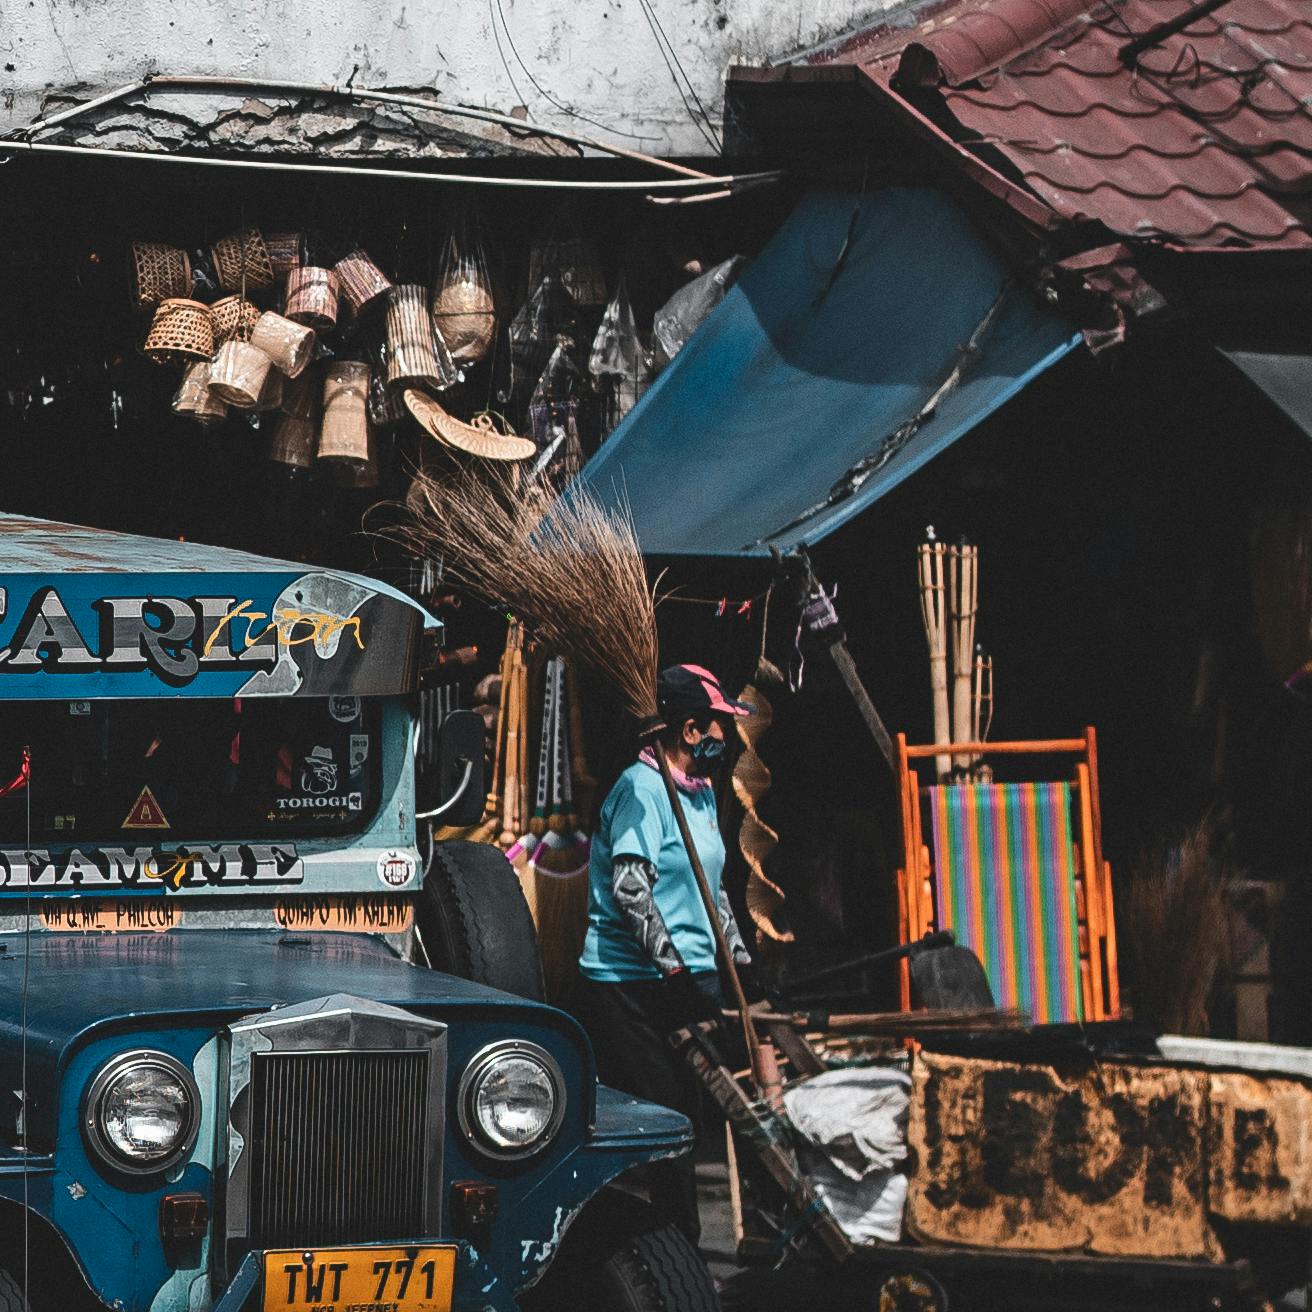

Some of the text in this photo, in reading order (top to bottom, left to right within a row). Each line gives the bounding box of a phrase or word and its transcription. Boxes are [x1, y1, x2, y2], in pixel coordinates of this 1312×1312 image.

[176, 843, 304, 886] ME
[284, 1259, 435, 1304] TWT 771
